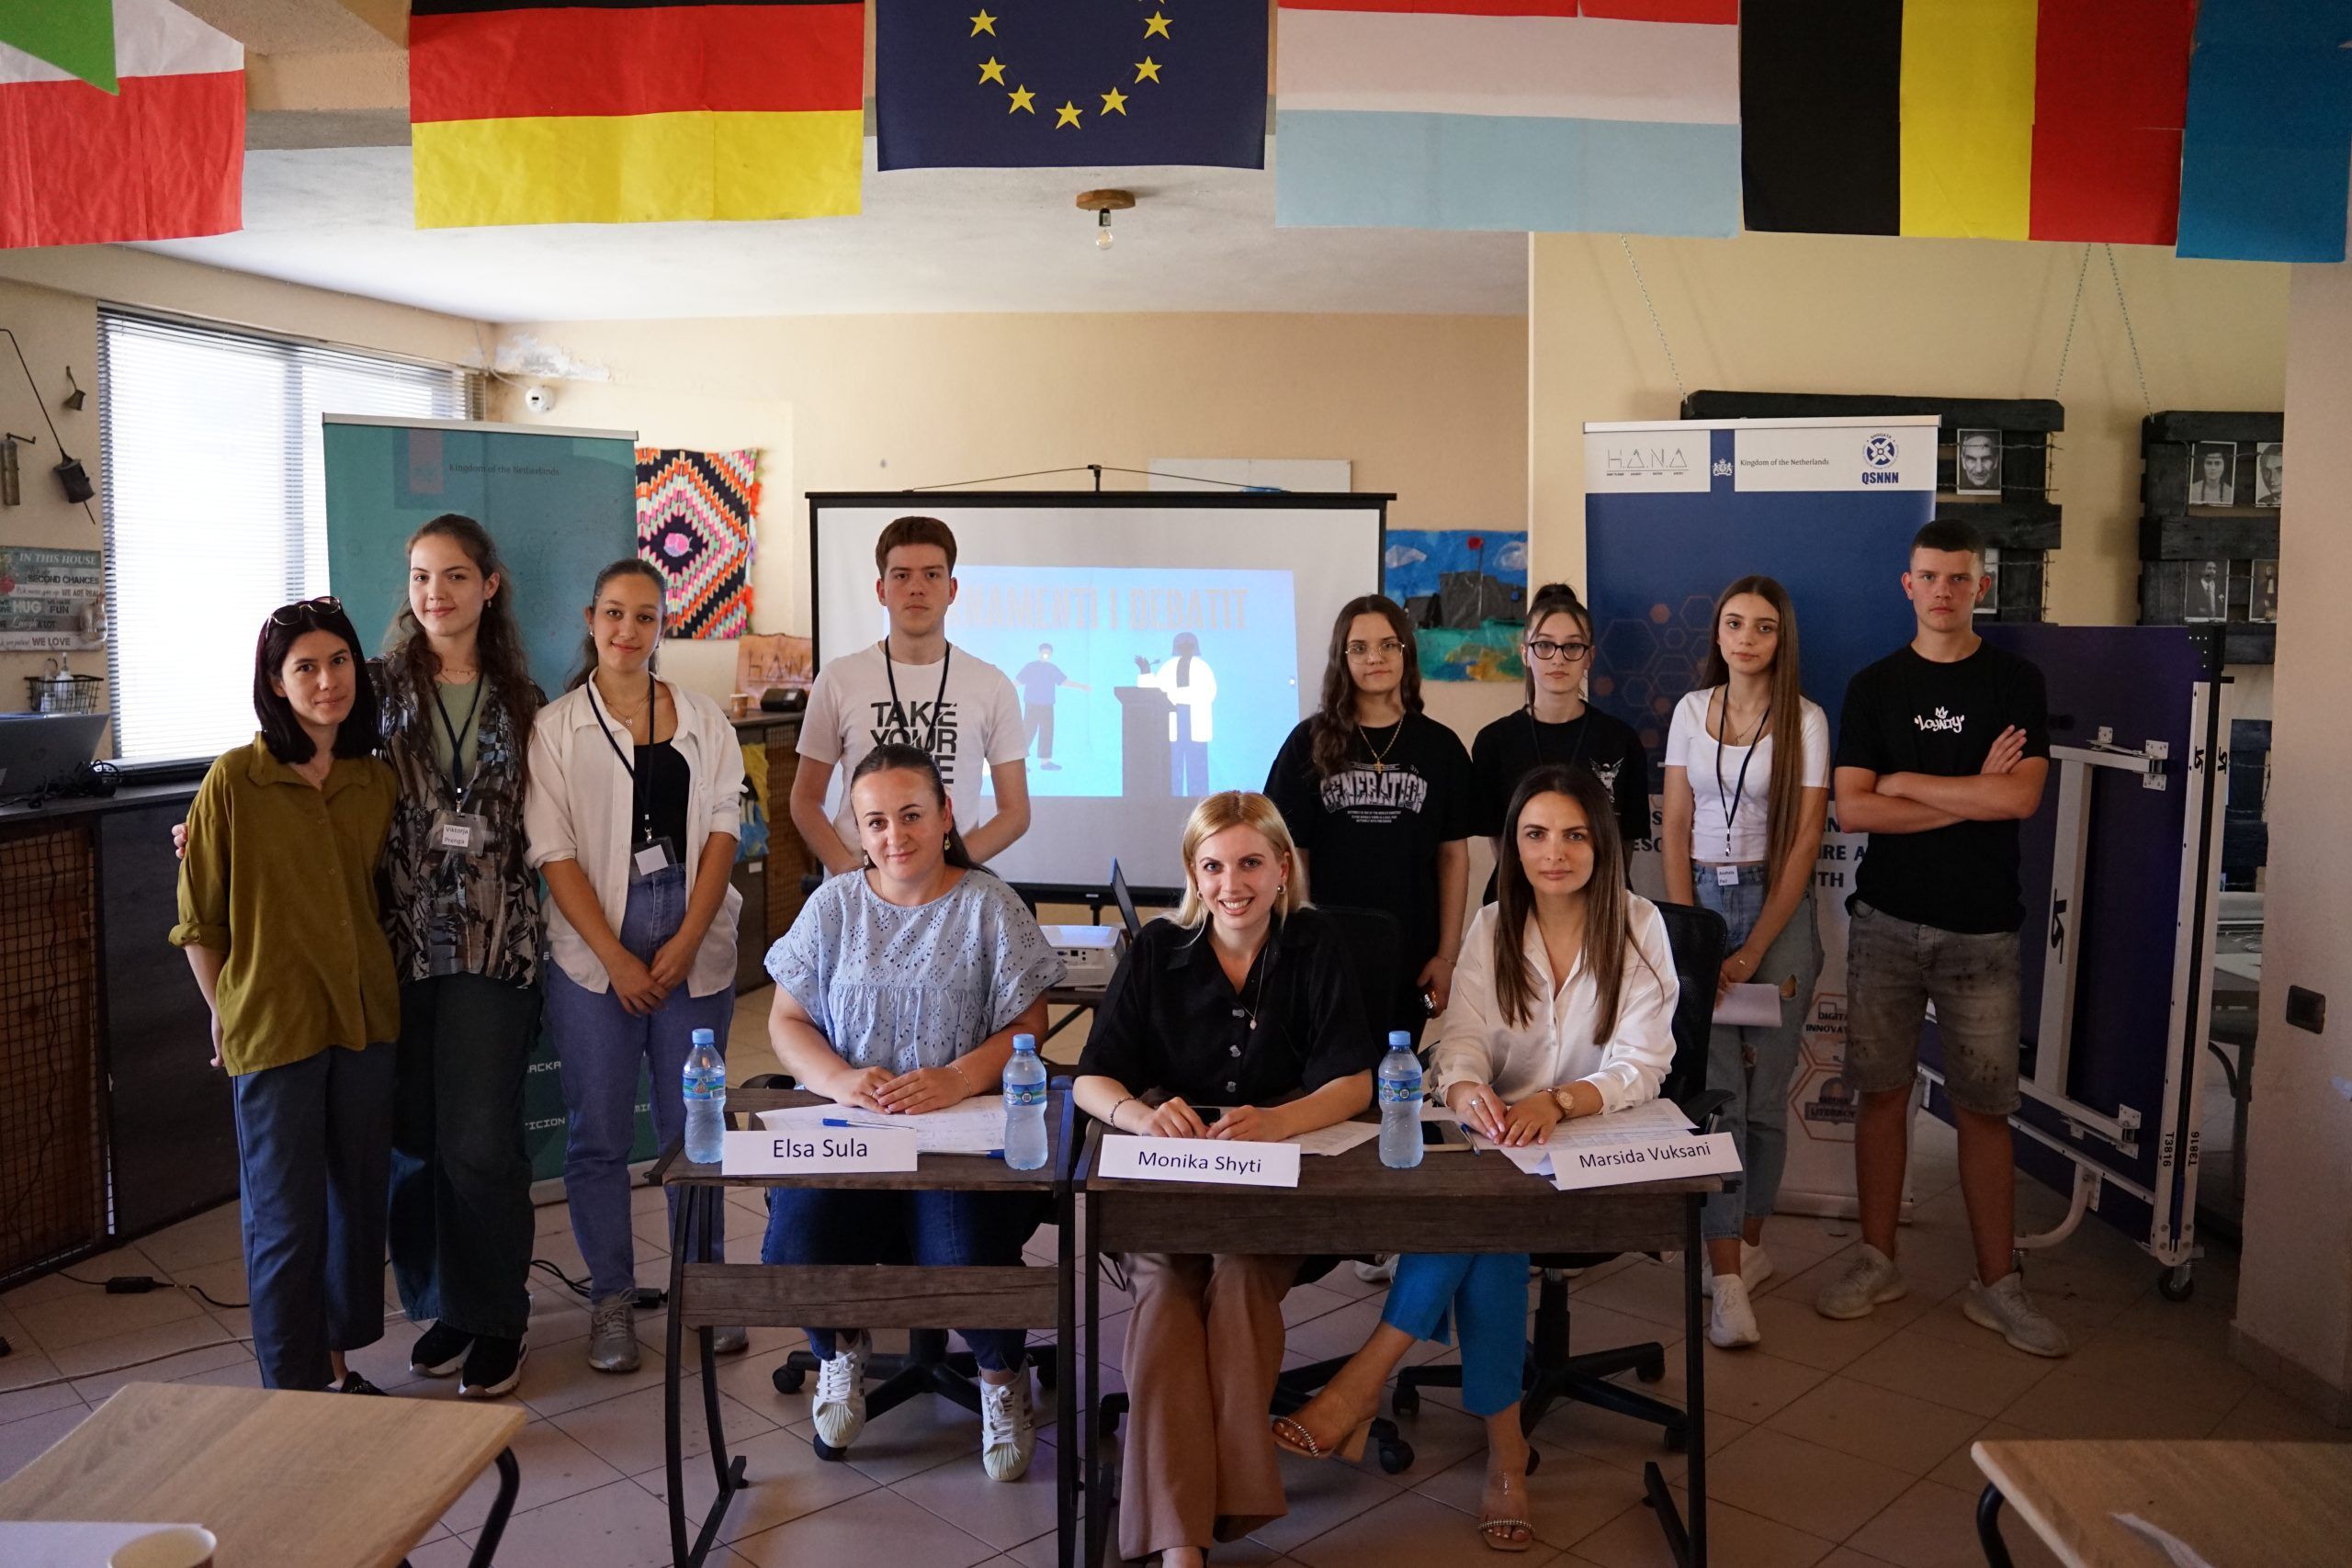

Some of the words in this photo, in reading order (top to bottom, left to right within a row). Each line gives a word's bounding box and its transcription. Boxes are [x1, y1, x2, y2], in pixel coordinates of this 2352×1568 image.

[449, 463, 486, 474] Kingdom
[487, 465, 496, 473] of
[498, 466, 511, 474] the
[513, 466, 560, 476] Netherlands
[1861, 471, 1899, 485] QSNNN
[19, 553, 31, 562] IN
[36, 554, 60, 564] THIS
[62, 555, 96, 565] HOUSE
[28, 574, 61, 584] SECOND
[62, 576, 99, 585] CHANCES
[13, 601, 42, 614] HUG
[50, 606, 70, 615] FUN
[1129, 588, 1249, 630] DEBATIT
[32, 637, 46, 646] WE
[48, 637, 71, 646] LOVE
[870, 701, 958, 728] TAKE
[870, 728, 958, 754] YOUR
[1320, 770, 1428, 814] GENERATION
[1805, 1024, 1847, 1033] INNOVA
[1810, 1107, 1856, 1118] LITERACY
[774, 1138, 815, 1157] Elsa
[822, 1138, 867, 1157] Sula
[1578, 1149, 1645, 1168] Marsida
[1647, 1142, 1711, 1161] Vuksani
[2163, 1132, 2175, 1167] T3816
[2188, 1131, 2199, 1167] T3816
[1138, 1151, 1208, 1169] Monika
[1215, 1156, 1261, 1175] Shyti
